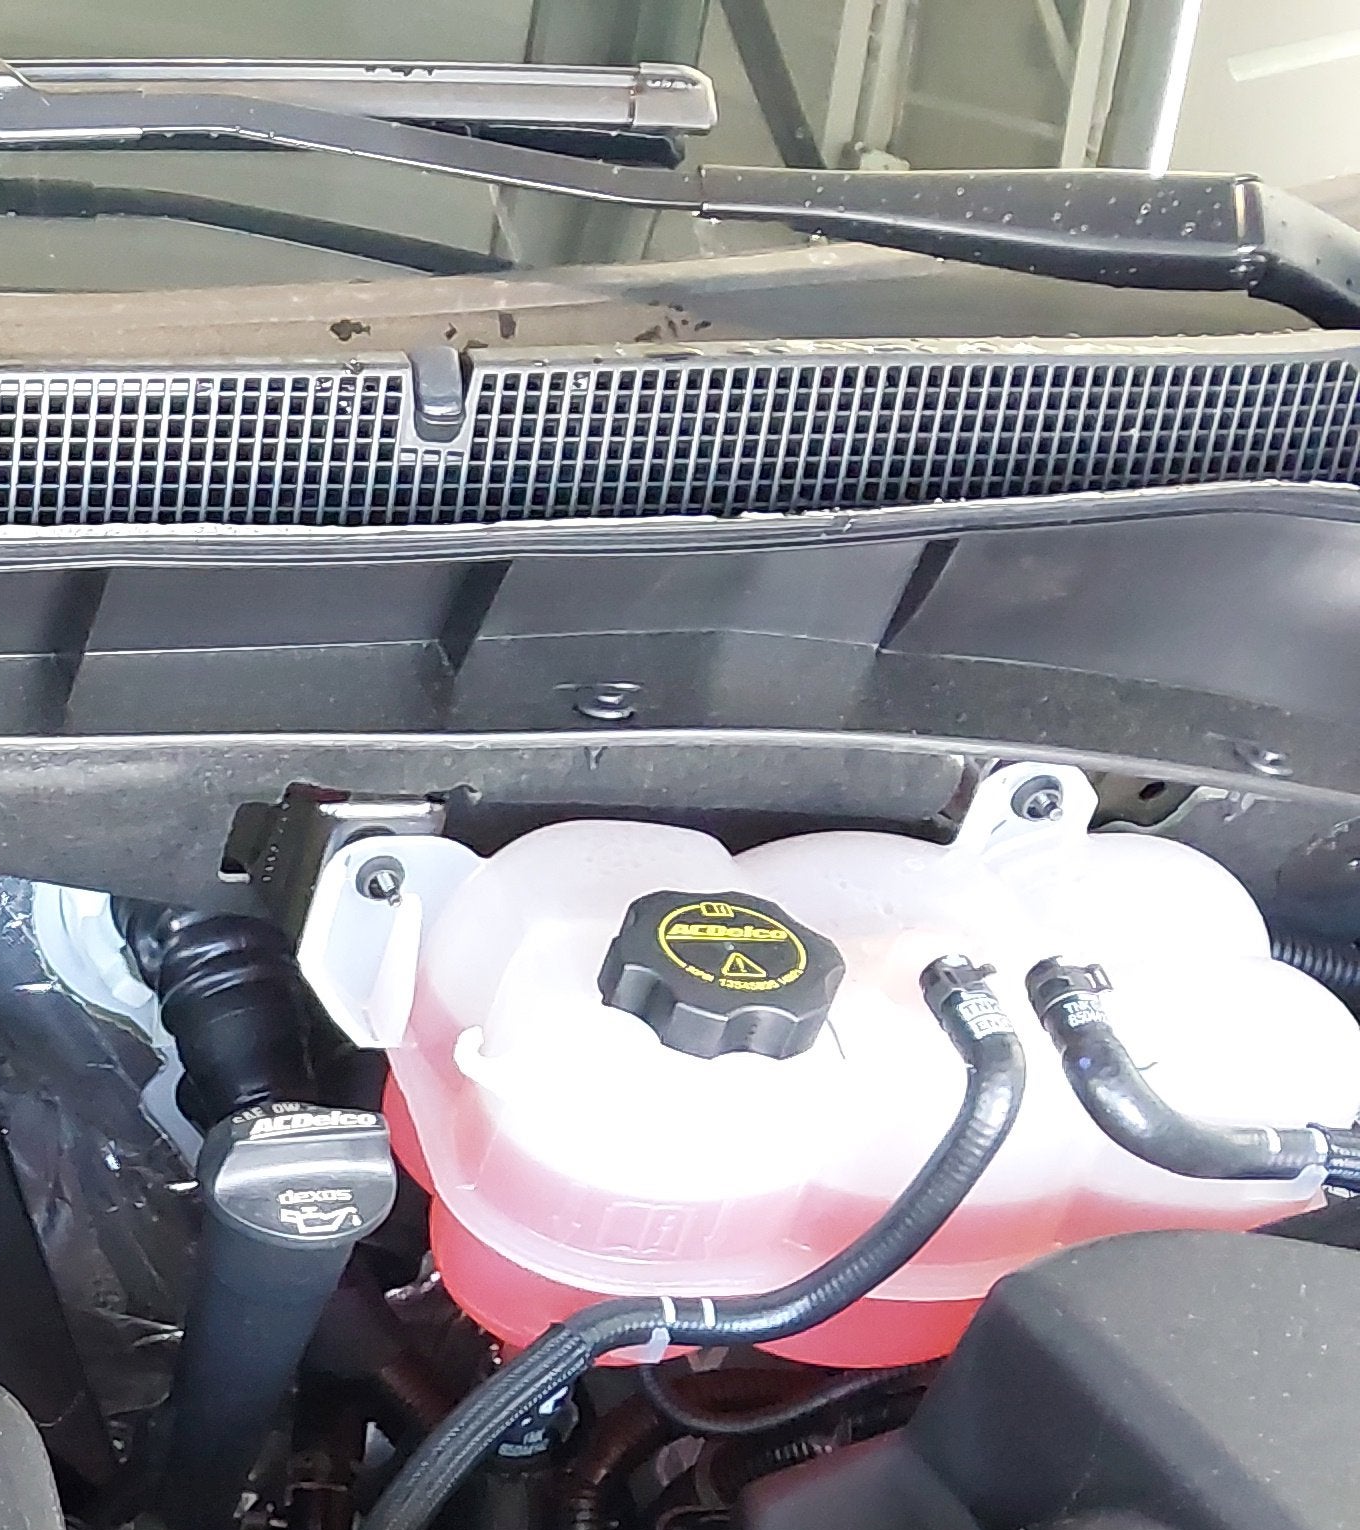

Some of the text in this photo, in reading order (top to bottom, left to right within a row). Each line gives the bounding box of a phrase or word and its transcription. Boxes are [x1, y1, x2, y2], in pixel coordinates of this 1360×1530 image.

[666, 924, 788, 940] ACDelco
[249, 1111, 377, 1136] ACDelco
[278, 1188, 353, 1205] dexos
